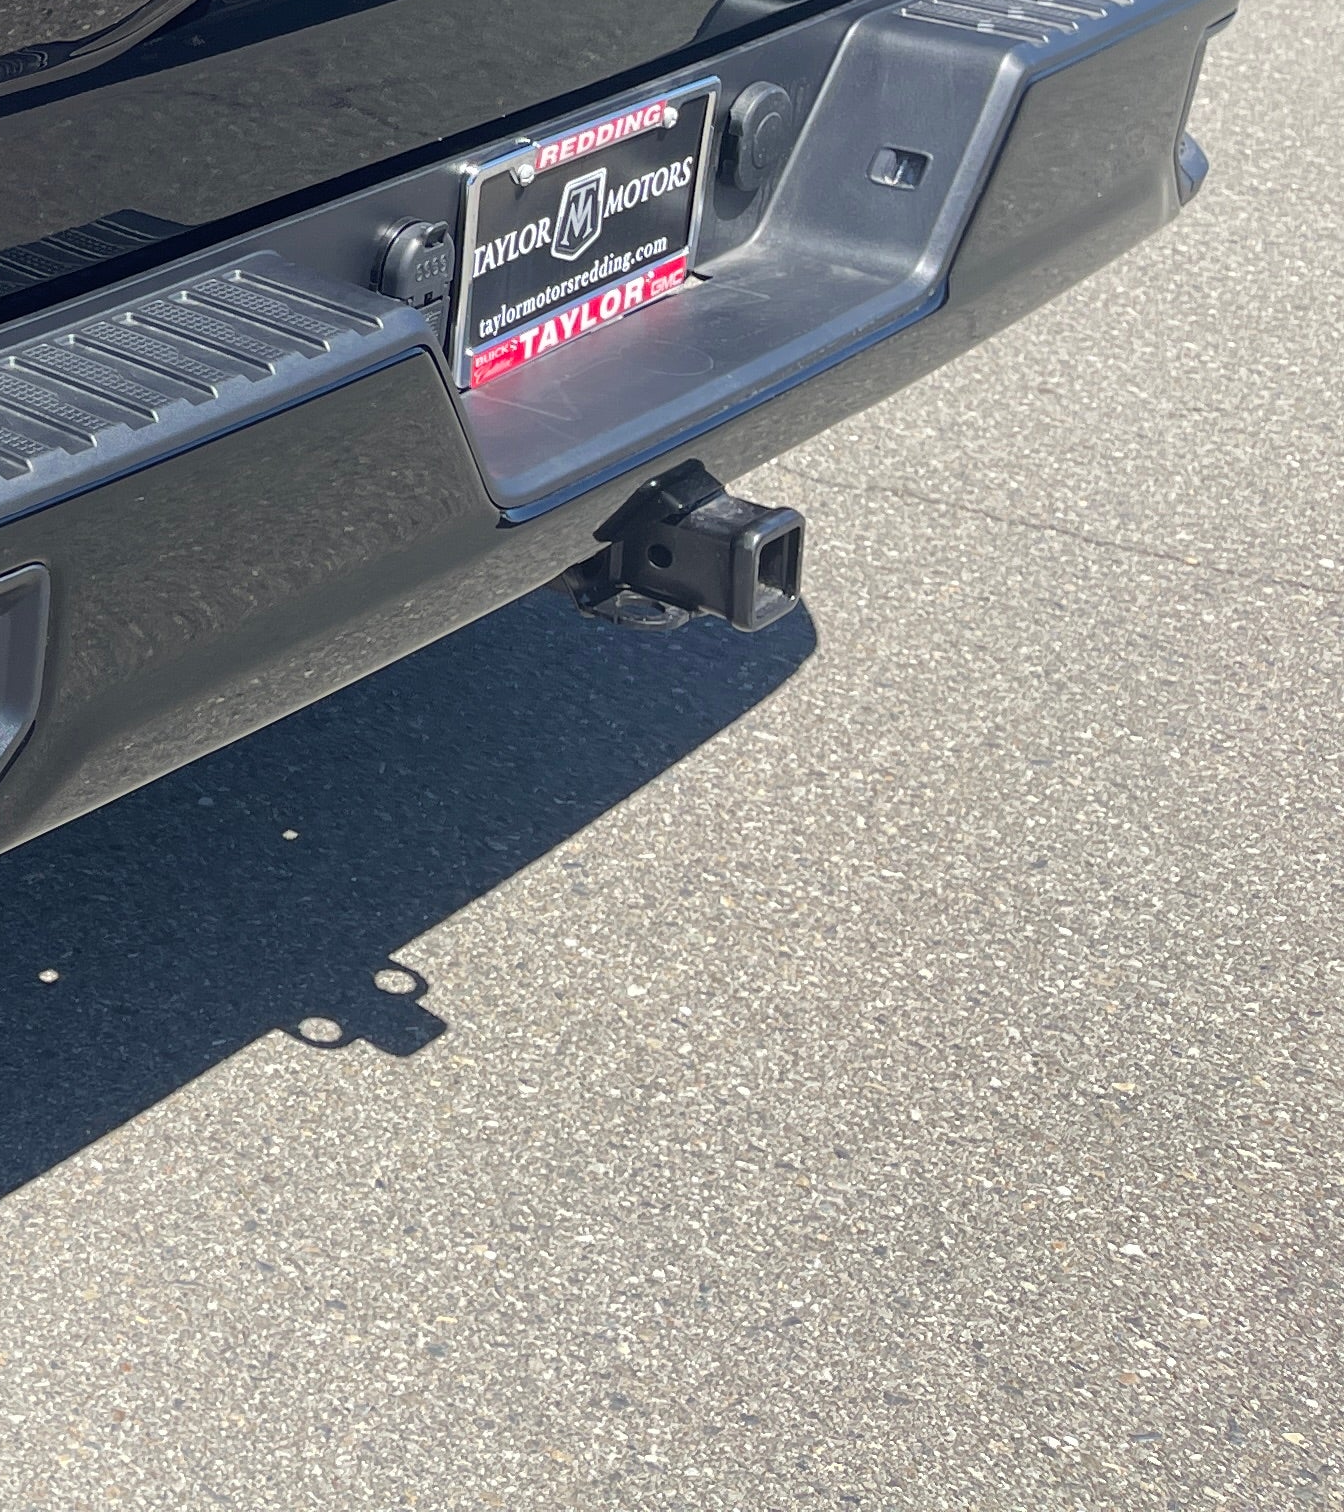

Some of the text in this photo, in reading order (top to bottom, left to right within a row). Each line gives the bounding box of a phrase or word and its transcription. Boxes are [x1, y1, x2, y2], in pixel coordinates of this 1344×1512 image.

[539, 104, 661, 168] REDDING
[472, 216, 552, 278] TAYLOR
[603, 156, 693, 219] MOTORS
[478, 236, 668, 339] taylormotorsredding.com
[519, 276, 645, 360] TAYLOR
[650, 268, 685, 297] GMC
